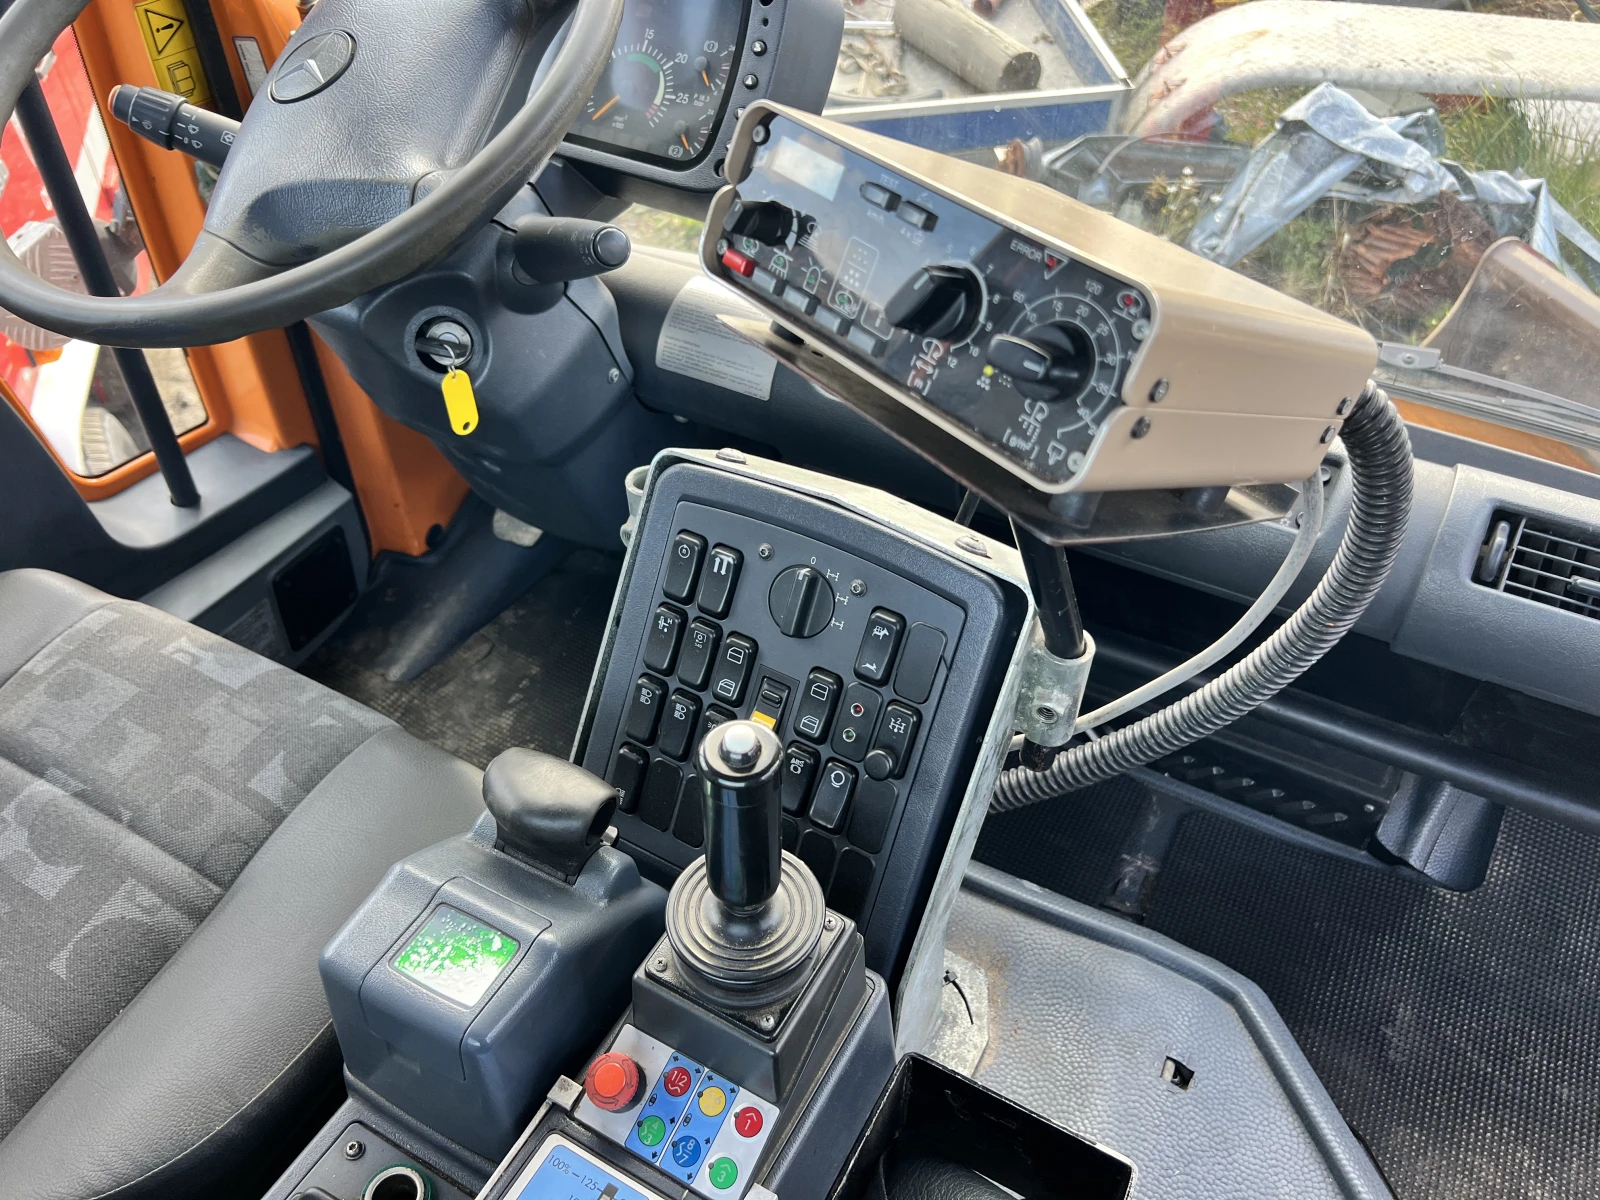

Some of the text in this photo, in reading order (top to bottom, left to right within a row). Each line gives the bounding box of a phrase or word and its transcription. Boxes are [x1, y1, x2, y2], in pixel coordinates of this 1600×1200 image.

[644, 28, 655, 40] 15
[674, 52, 689, 64] 20
[675, 92, 690, 104] 25
[881, 173, 899, 189] TEST
[1010, 239, 1043, 263] ERROR
[986, 263, 994, 274] 7
[1084, 279, 1102, 296] 120
[993, 293, 1000, 305] 8
[1012, 289, 1025, 304] 60
[1052, 300, 1063, 313] 15
[1075, 304, 1089, 318] 20
[1026, 311, 1037, 324] 10
[984, 322, 993, 332] 9
[1096, 322, 1110, 337] 25
[968, 343, 980, 358] 10
[947, 355, 958, 369] 12
[1104, 352, 1117, 366] 30
[1095, 382, 1109, 397] 35
[1077, 406, 1091, 422] 40
[810, 557, 817, 565] 0
[547, 1154, 572, 1175] 100%
[717, 1170, 726, 1182] 3
